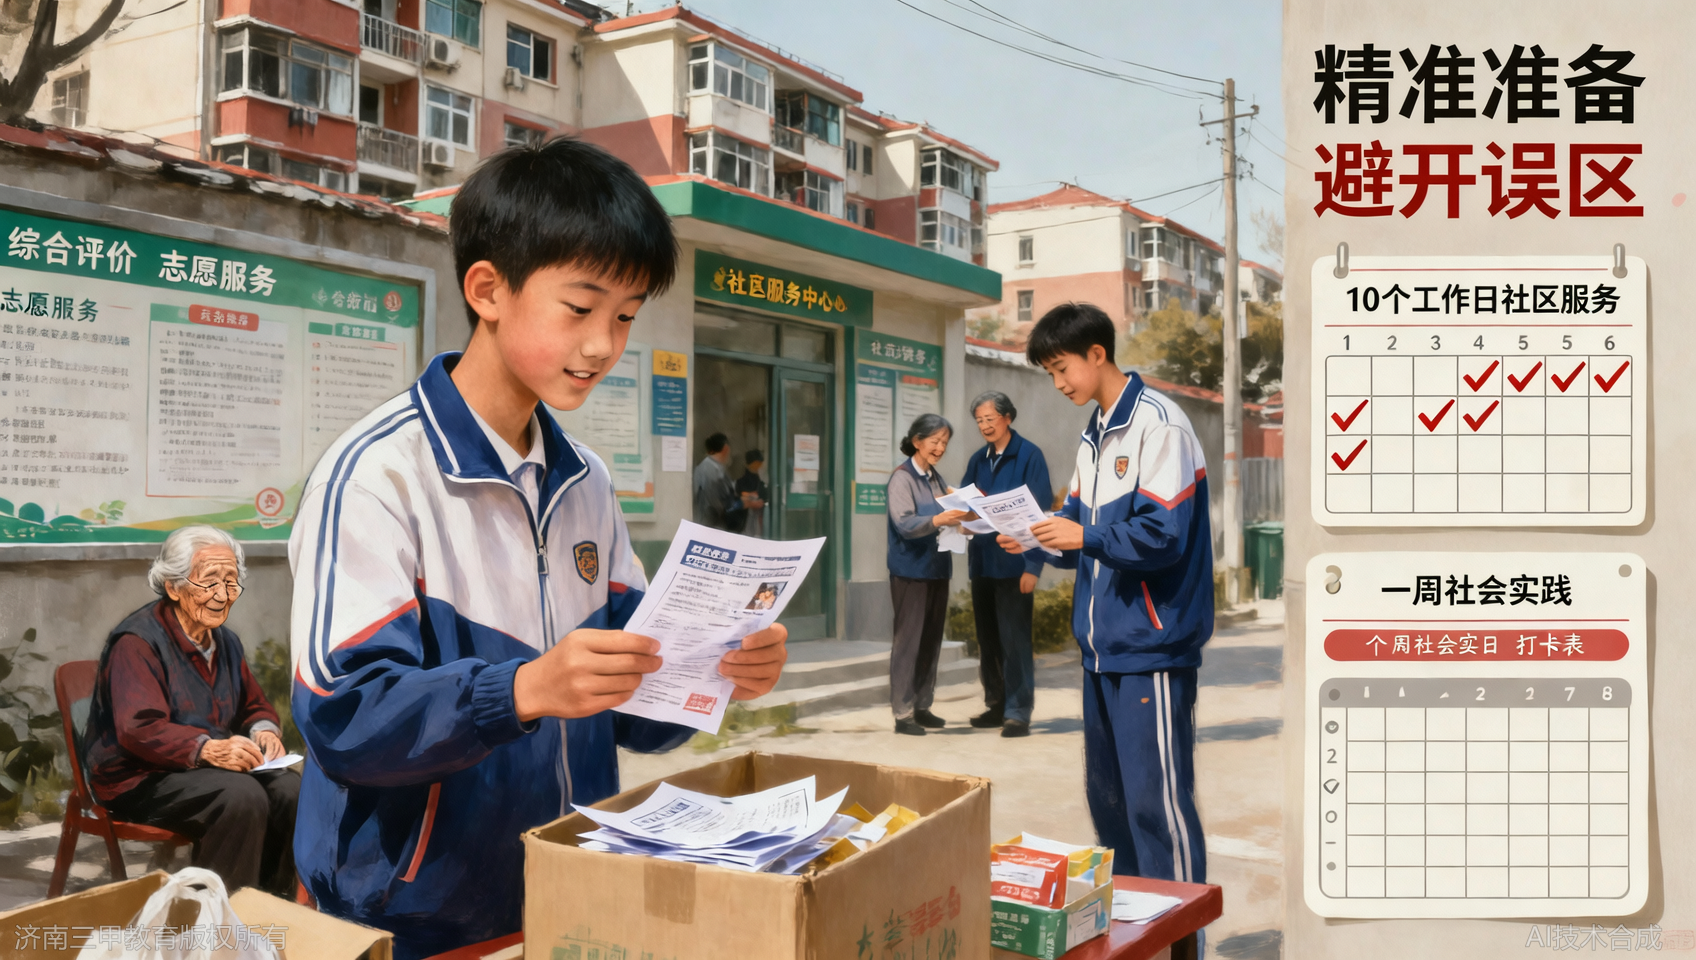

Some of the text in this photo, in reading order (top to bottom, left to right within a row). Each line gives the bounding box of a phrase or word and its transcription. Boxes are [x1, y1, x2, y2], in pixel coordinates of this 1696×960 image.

[1313, 43, 1647, 125] 精准准备
[1313, 139, 1644, 220] 避开误区
[7, 226, 278, 298] 综合评价 志愿服务
[0, 287, 99, 323] 志愿服务
[1346, 283, 1621, 315] 10个工作日社区服务
[1343, 334, 1616, 351] 1 2 3 4 5 5 6
[1381, 573, 1573, 607] 一周社会实践
[1365, 632, 1585, 657] 个周社会实日 打卡表
[1475, 686, 1486, 701] 2
[1564, 686, 1576, 702] 7
[1601, 685, 1613, 701] 8
[1326, 748, 1338, 764] 2
